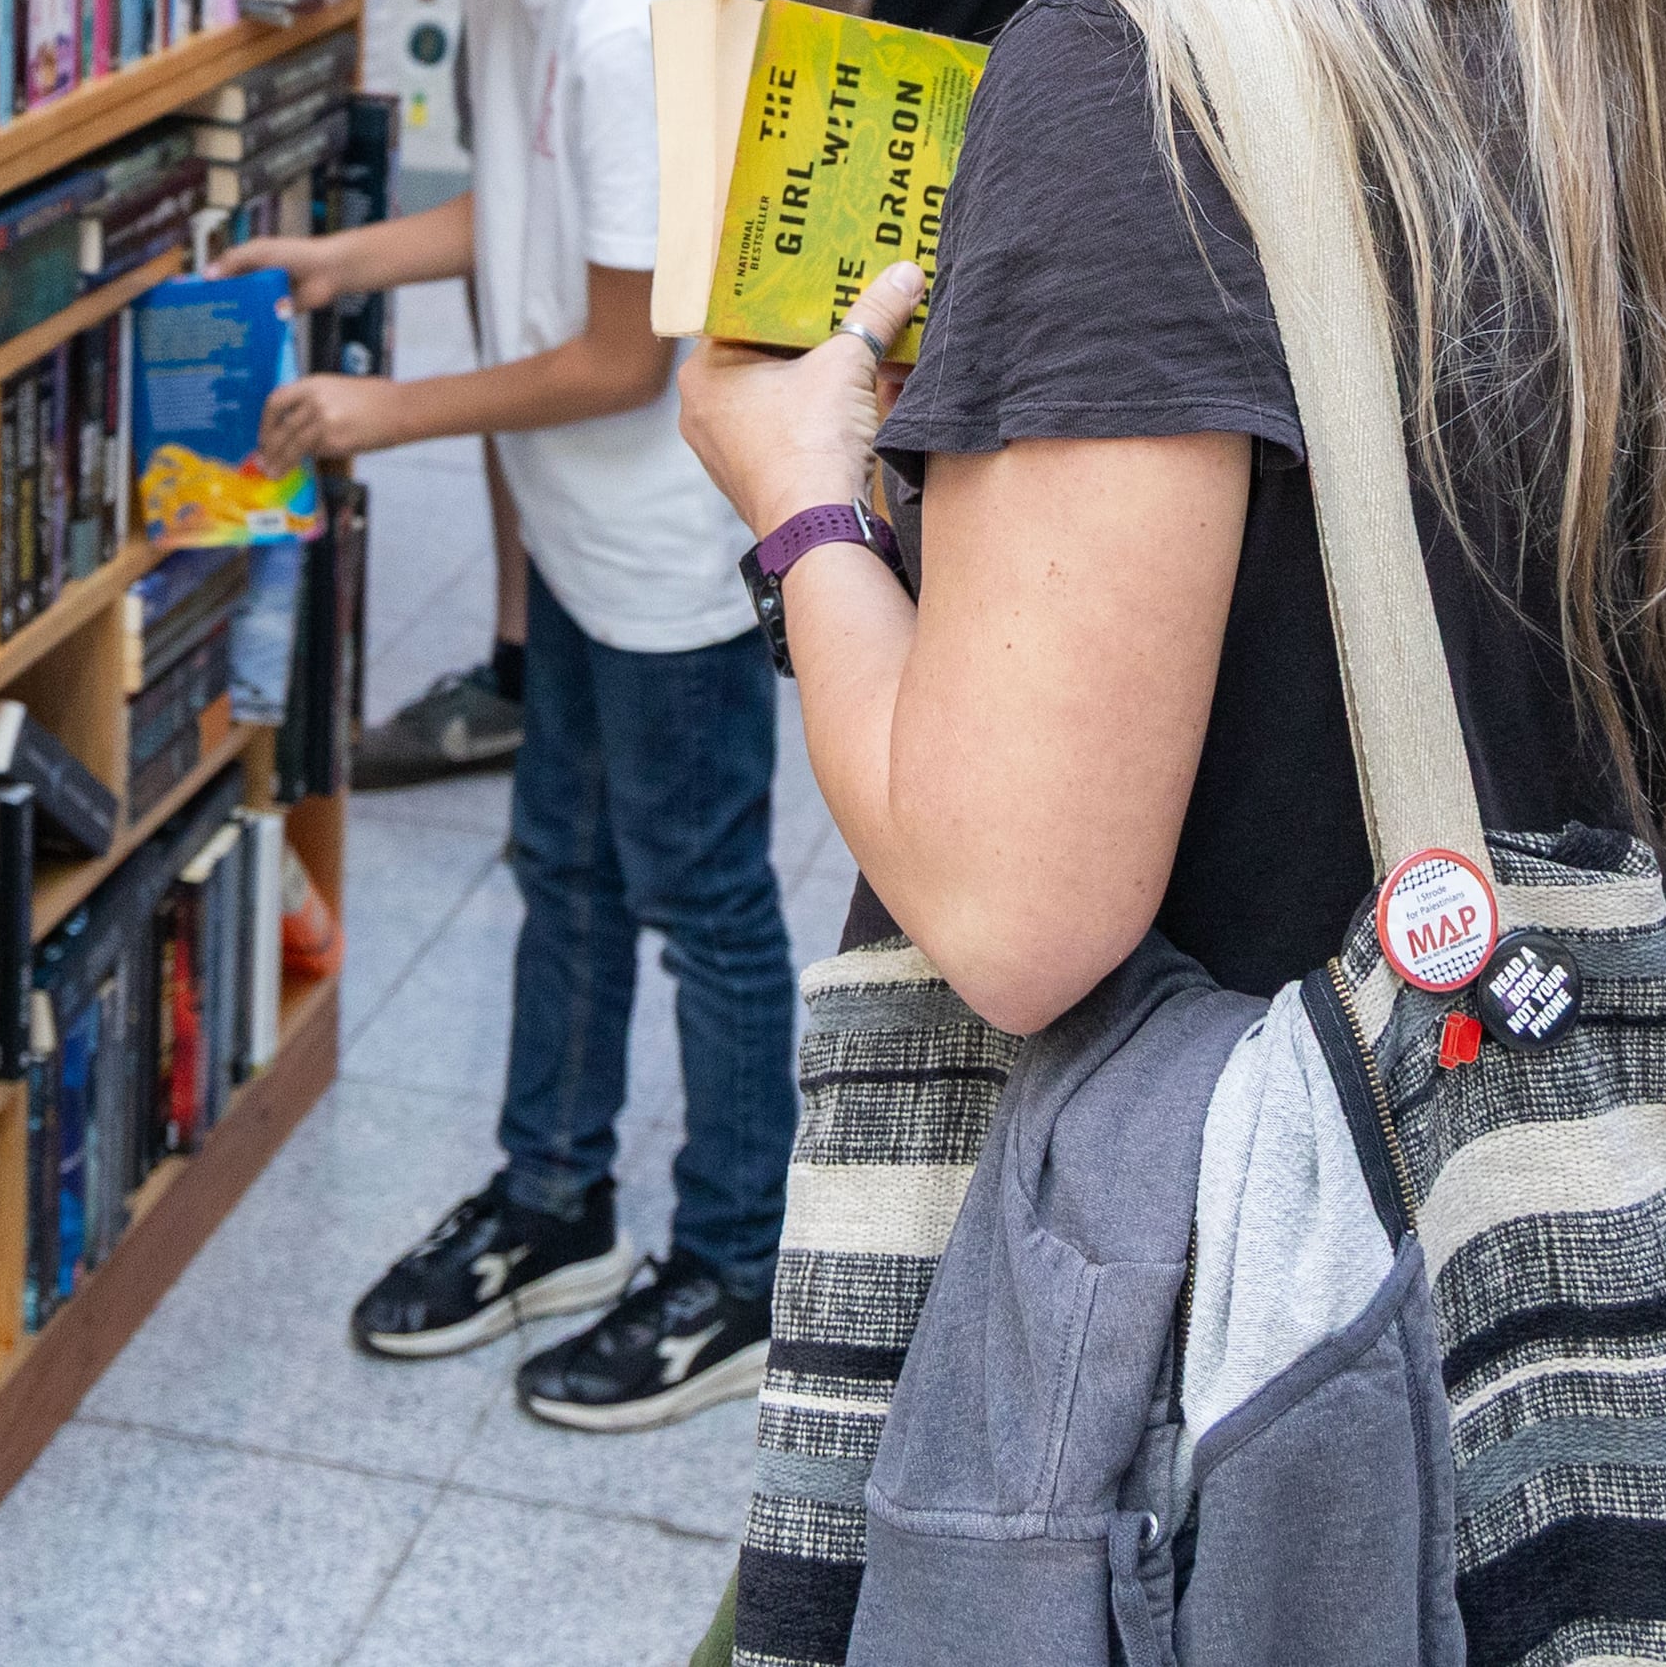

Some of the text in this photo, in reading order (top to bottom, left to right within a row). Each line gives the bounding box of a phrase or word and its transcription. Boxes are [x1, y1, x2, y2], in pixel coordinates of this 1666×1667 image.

[759, 65, 797, 143] THE
[819, 62, 862, 171] WITH
[874, 78, 925, 247] DRAGON
[749, 194, 771, 272] BESTSELLER
[774, 159, 815, 257] GIRL
[732, 217, 757, 298] #1 NATIONAL
[830, 255, 865, 332] THE
[1406, 889, 1466, 921] for Palestinians
[1416, 883, 1448, 904] I Strode
[1406, 904, 1477, 959] MAP
[1488, 944, 1538, 999] READ A
[1506, 963, 1570, 1036] NOT YOUR
[1507, 963, 1546, 1004] BOOK
[1528, 988, 1574, 1040] PHONE
